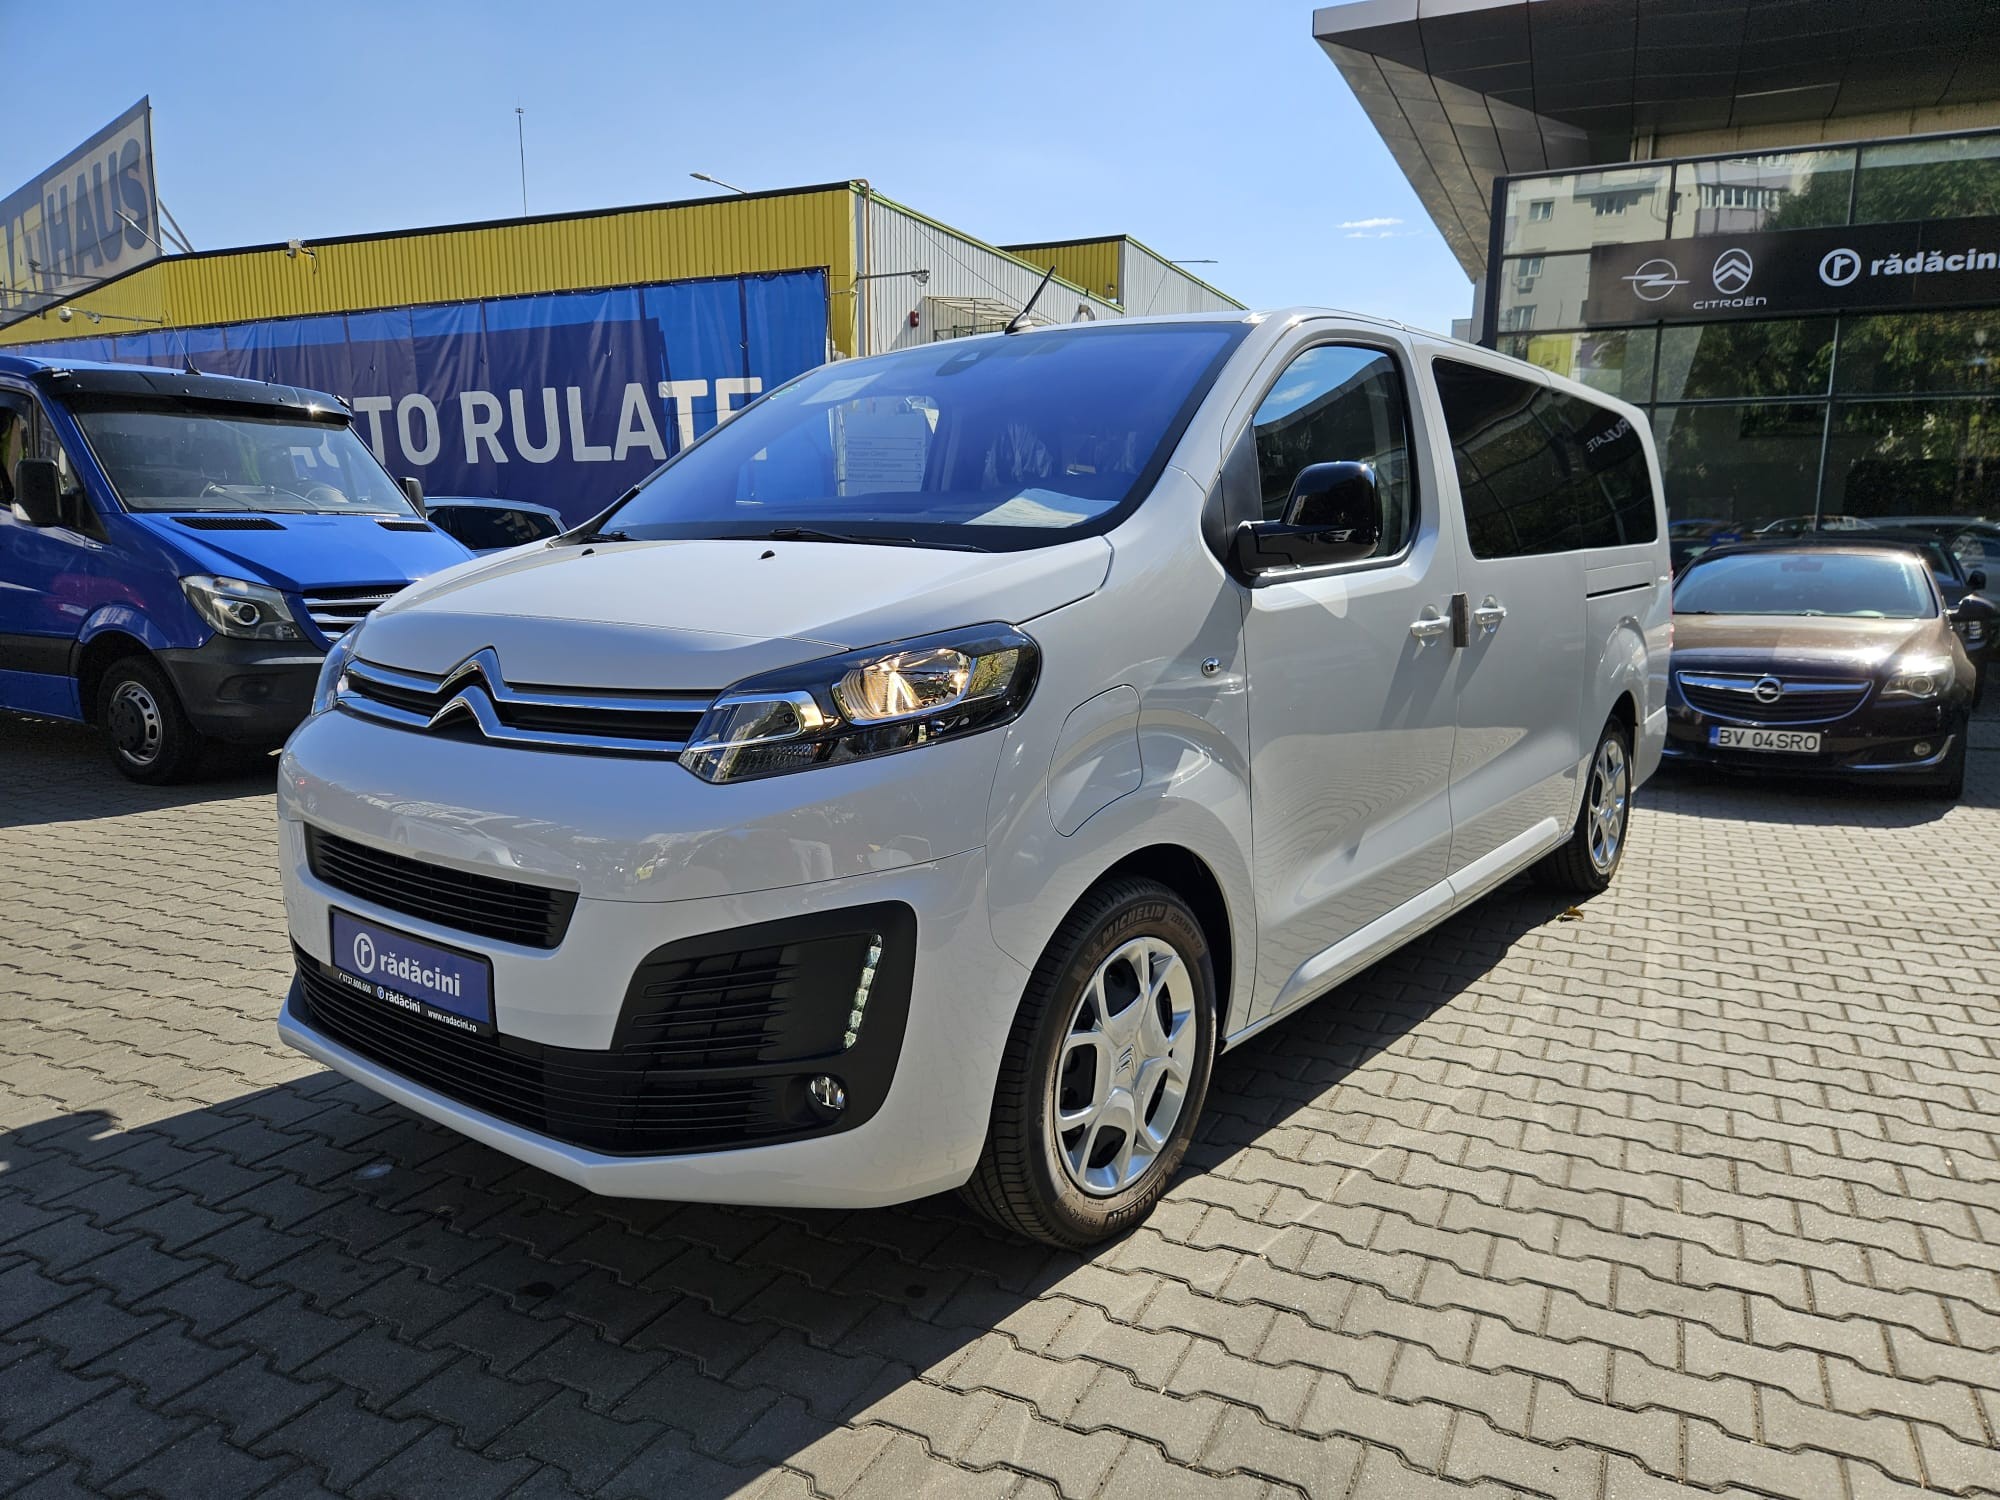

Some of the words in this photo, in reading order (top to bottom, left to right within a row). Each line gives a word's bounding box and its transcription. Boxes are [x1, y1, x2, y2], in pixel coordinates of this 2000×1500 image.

[1870, 248, 2000, 276] rădăcin
[1720, 729, 1745, 745] BV
[1102, 904, 1167, 944] MICHELIN
[379, 952, 460, 997] rădăcini
[427, 1009, 477, 1033] www.radacini.ro
